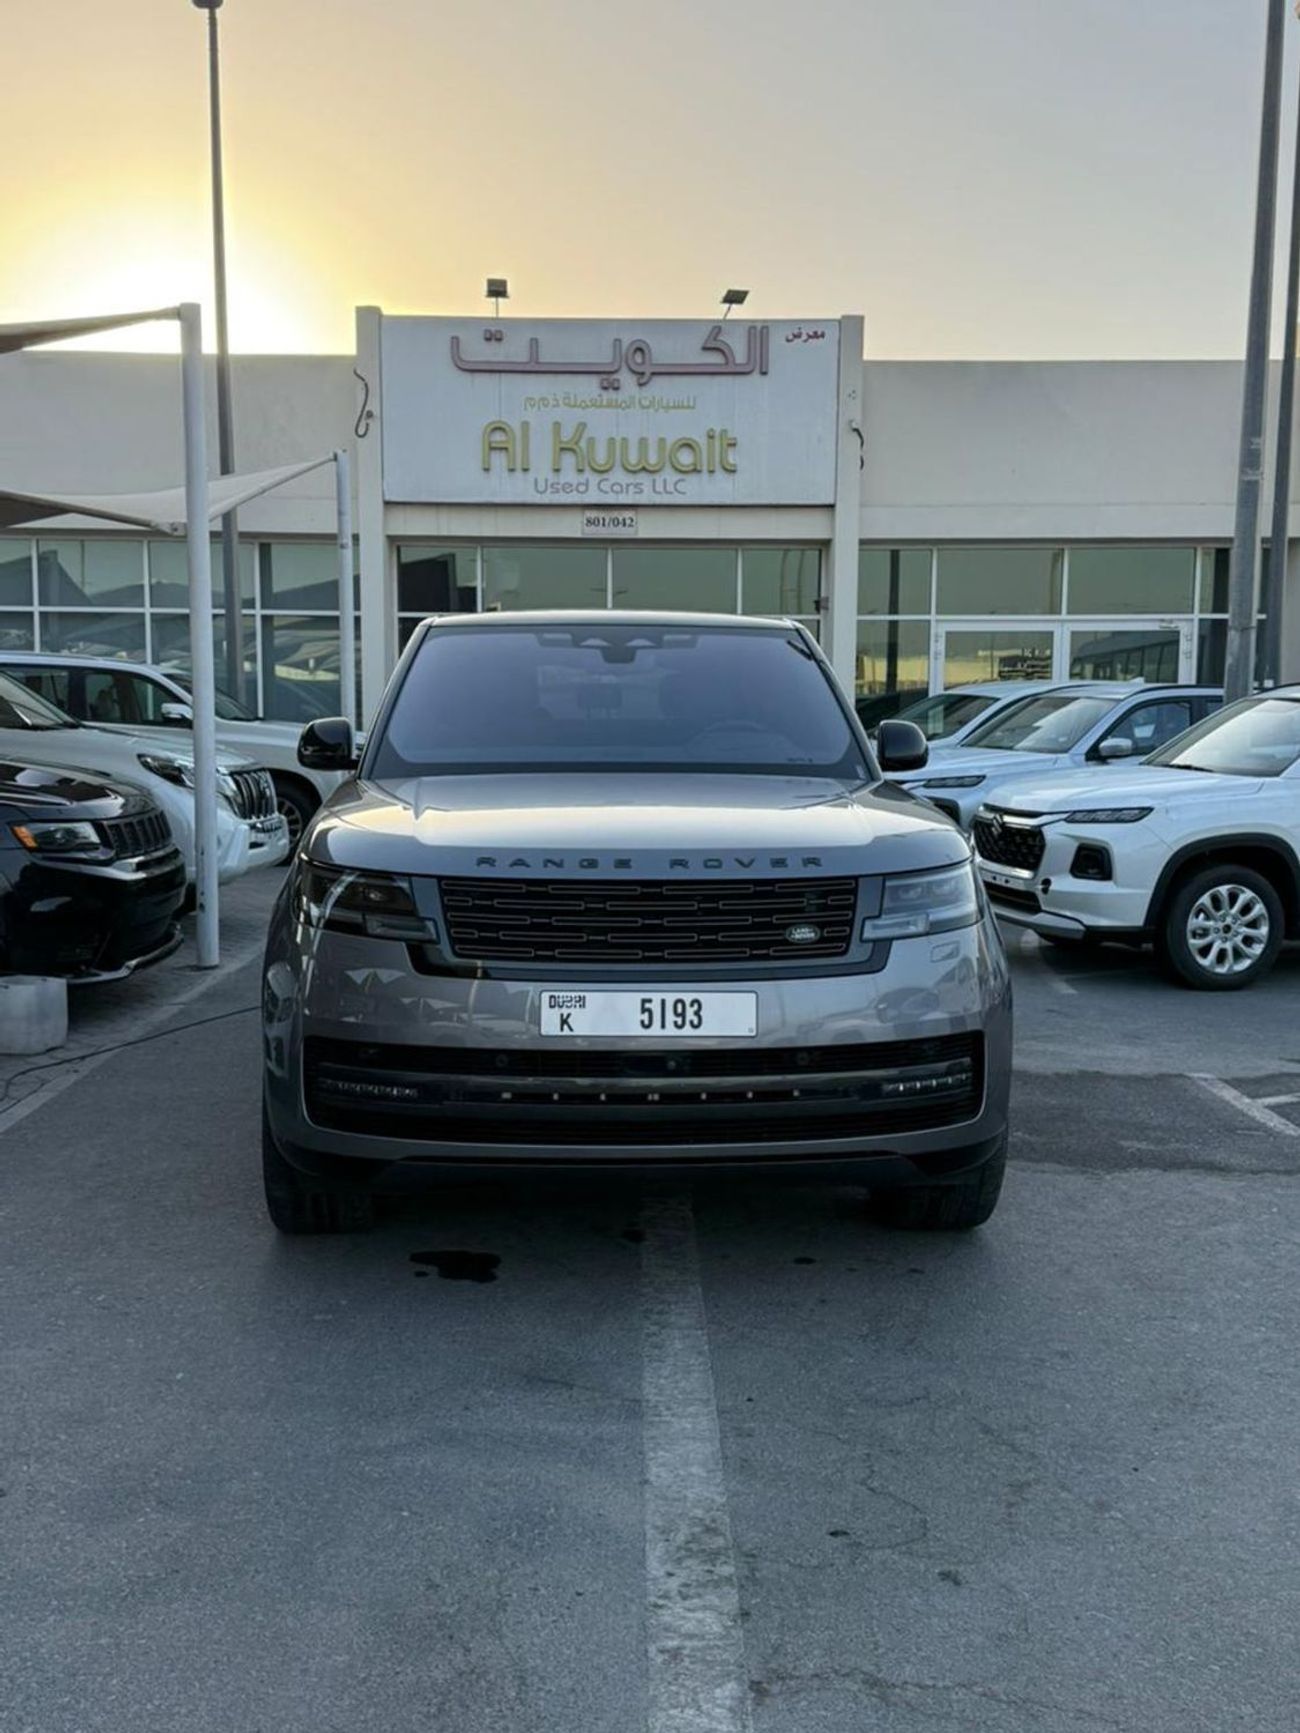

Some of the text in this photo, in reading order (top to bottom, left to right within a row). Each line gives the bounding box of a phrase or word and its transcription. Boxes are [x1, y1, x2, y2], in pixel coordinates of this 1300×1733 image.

[785, 327, 825, 343] معرض
[451, 326, 769, 390] الكويت
[562, 391, 636, 410] المستعملة
[639, 394, 696, 411] للسيارات
[482, 420, 737, 473] Al Kuwait
[534, 477, 687, 495] Used Cars LLC
[585, 516, 634, 528] 801/042
[476, 856, 822, 870] RANGE ROVER
[560, 1013, 574, 1032] K
[640, 998, 703, 1029] 5193
